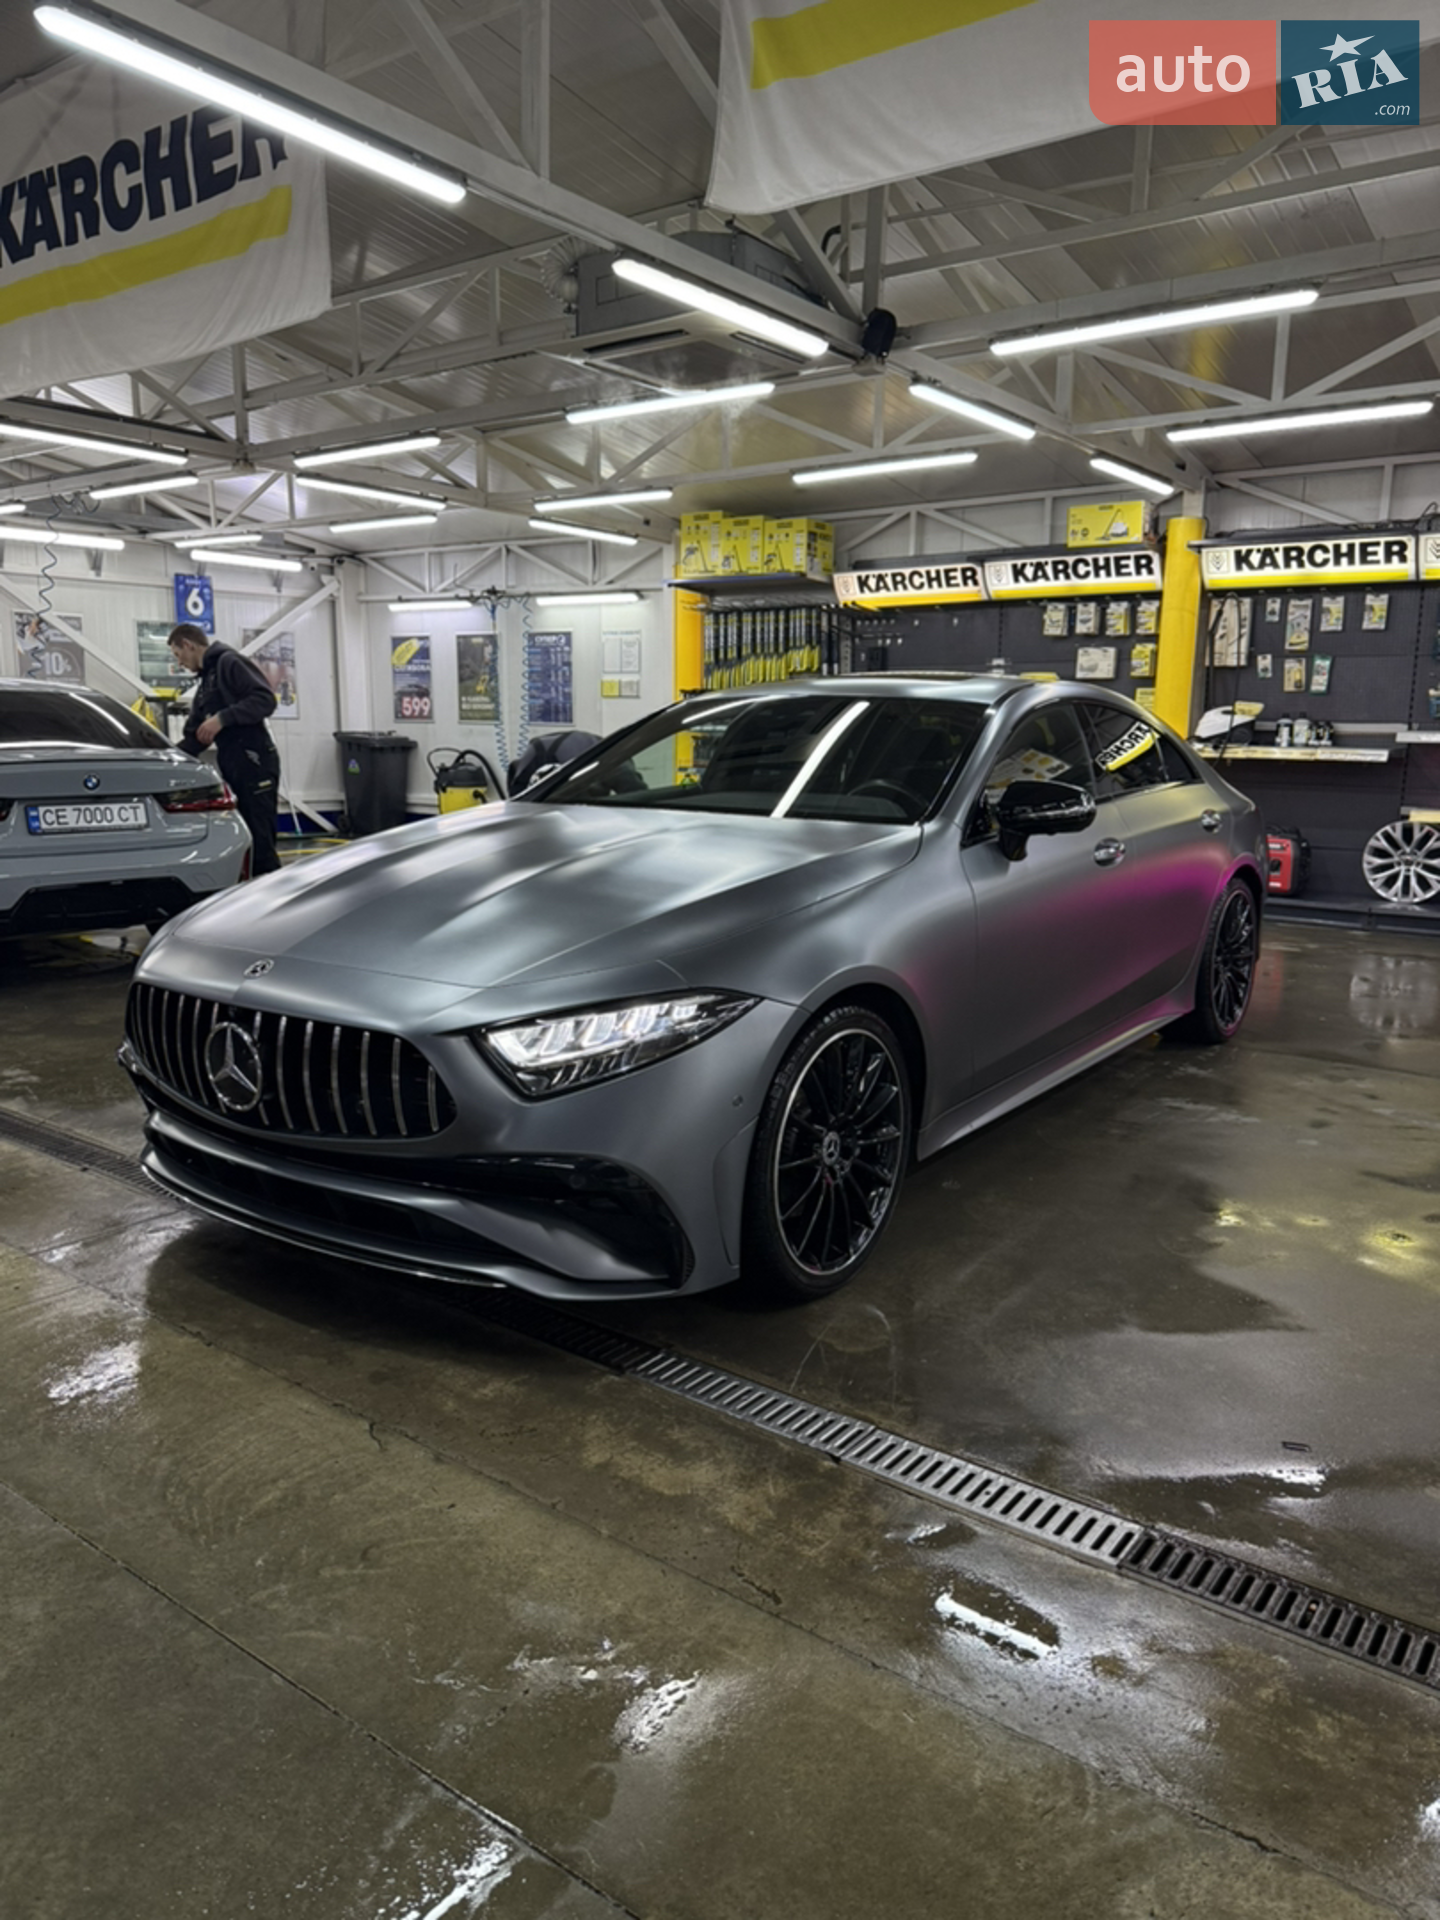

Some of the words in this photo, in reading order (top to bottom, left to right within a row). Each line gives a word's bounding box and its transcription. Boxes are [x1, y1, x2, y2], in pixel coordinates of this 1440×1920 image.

[1011, 553, 1155, 584] KÄRCHER
[1233, 540, 1409, 572] KÄRCHER
[856, 566, 979, 595] KÄRCHER
[186, 587, 204, 616] 6
[402, 696, 431, 717] 599
[42, 808, 69, 826] CE
[72, 806, 114, 825] 7000
[117, 805, 141, 822] CT
